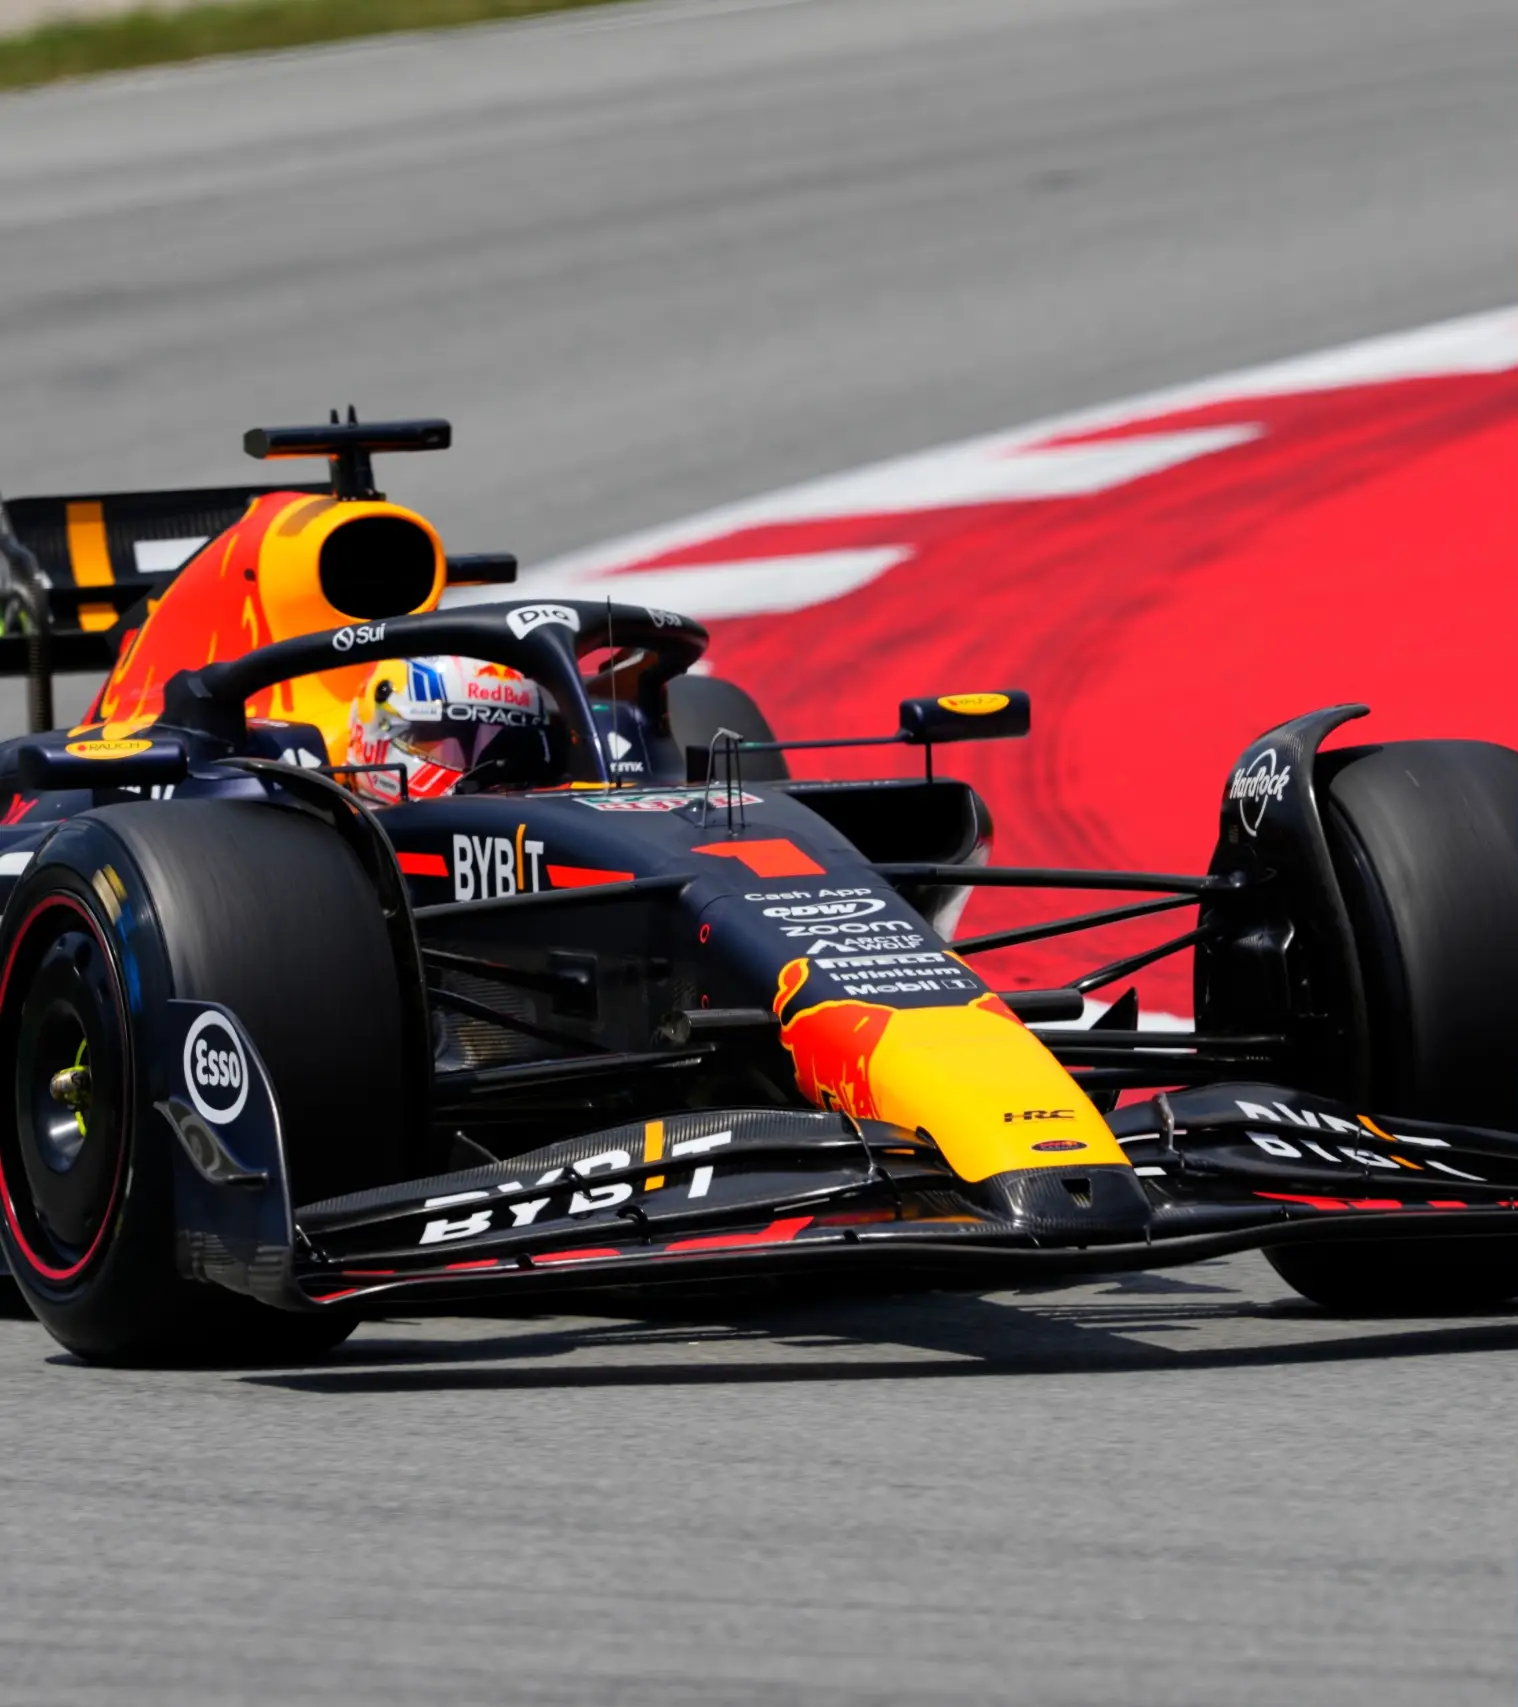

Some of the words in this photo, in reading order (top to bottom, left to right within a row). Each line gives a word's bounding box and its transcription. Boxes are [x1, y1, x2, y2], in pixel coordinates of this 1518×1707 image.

[356, 623, 387, 644] Sui
[468, 683, 502, 701] Red
[453, 824, 544, 901] BYBIT
[744, 891, 811, 901] Cash
[818, 888, 872, 897] App
[845, 935, 924, 946] ARCTIC
[857, 942, 923, 951] WOLF
[814, 952, 946, 969] PIRELLI
[844, 981, 940, 996] Mobil
[1004, 1109, 1075, 1123] HRC
[419, 1120, 732, 1244] BYBIT
